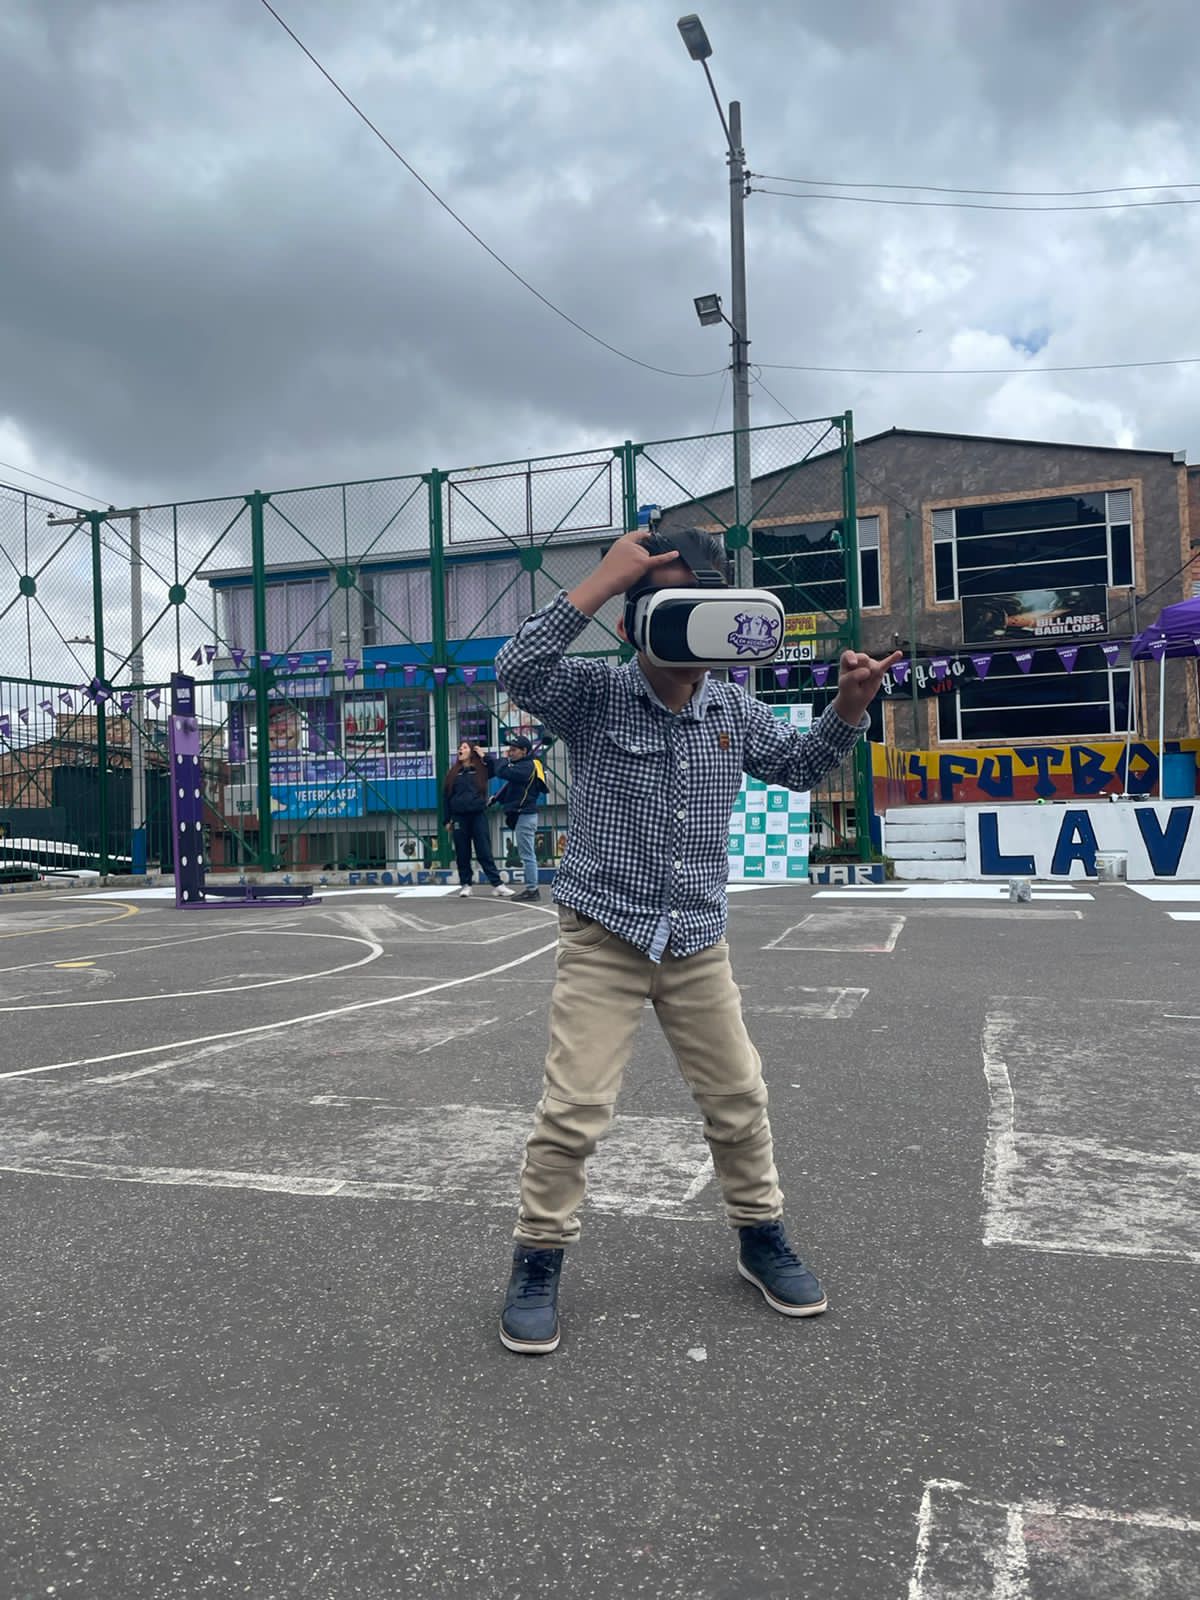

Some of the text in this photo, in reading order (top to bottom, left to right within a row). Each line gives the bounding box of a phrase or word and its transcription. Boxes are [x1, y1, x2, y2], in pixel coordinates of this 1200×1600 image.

[1036, 614, 1101, 627] BILLARES
[1034, 622, 1105, 636] BABILONIA
[940, 743, 1181, 801] FUTBO
[295, 788, 358, 802] VETERINARIA
